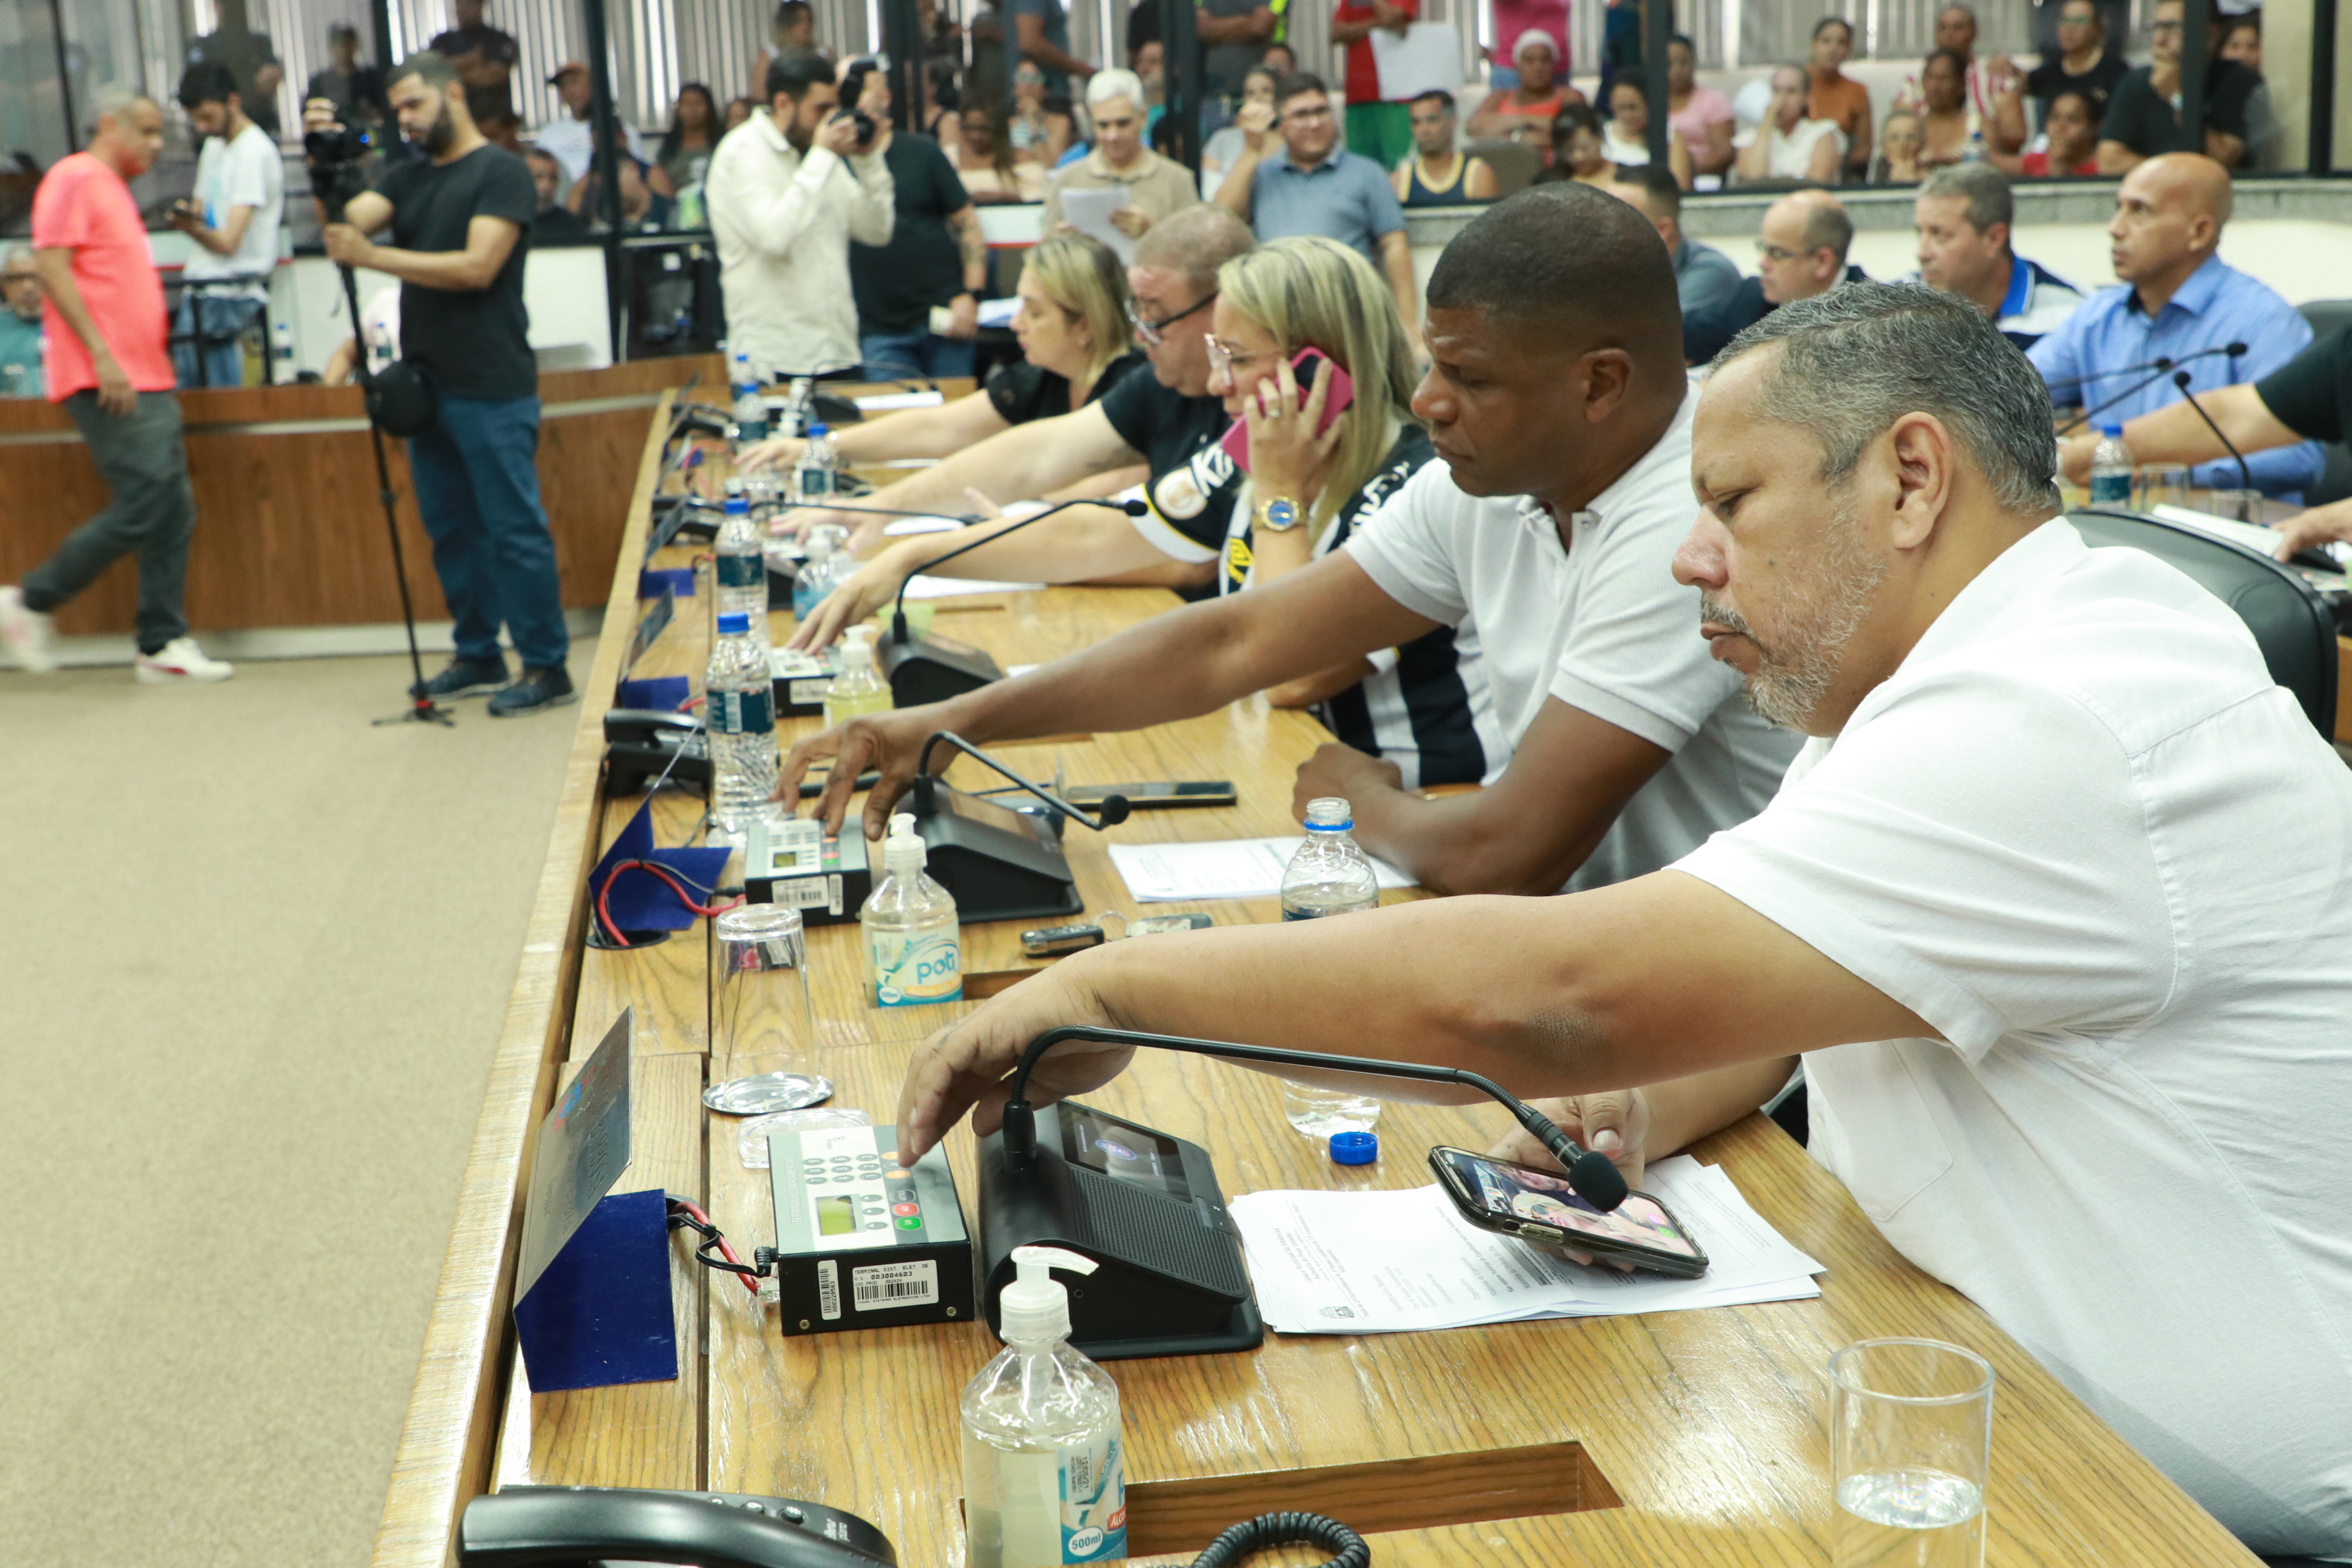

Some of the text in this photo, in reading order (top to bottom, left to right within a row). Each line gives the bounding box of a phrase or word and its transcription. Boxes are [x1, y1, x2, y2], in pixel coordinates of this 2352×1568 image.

[785, 1157, 798, 1190] PARLAMENTAR
[789, 1198, 802, 1223] TERMINAL
[1298, 1215, 1312, 1234] Legislatura
[1272, 1228, 1288, 1246] Estância
[1284, 1233, 1298, 1247] Grande
[1286, 1252, 1303, 1269] Municipal
[1294, 1247, 1305, 1257] Praia
[1326, 1249, 1341, 1264] Legislatura
[1325, 1259, 1335, 1268] Sessão
[1459, 1256, 1481, 1275] Expediente
[1497, 1256, 1512, 1269] Ordem
[870, 1270, 912, 1279] 003004603
[1299, 1270, 1313, 1283] Câmara
[1513, 1273, 1531, 1288] Matérias
[1371, 1275, 1404, 1311] Identificação Básica
[1425, 1273, 1455, 1304] Correspondências
[1459, 1279, 1481, 1299] Expedientes
[1480, 1280, 1499, 1296] Matérias
[1081, 1456, 1090, 1489] 12/05/21
[1072, 1533, 1101, 1551] 500ml
